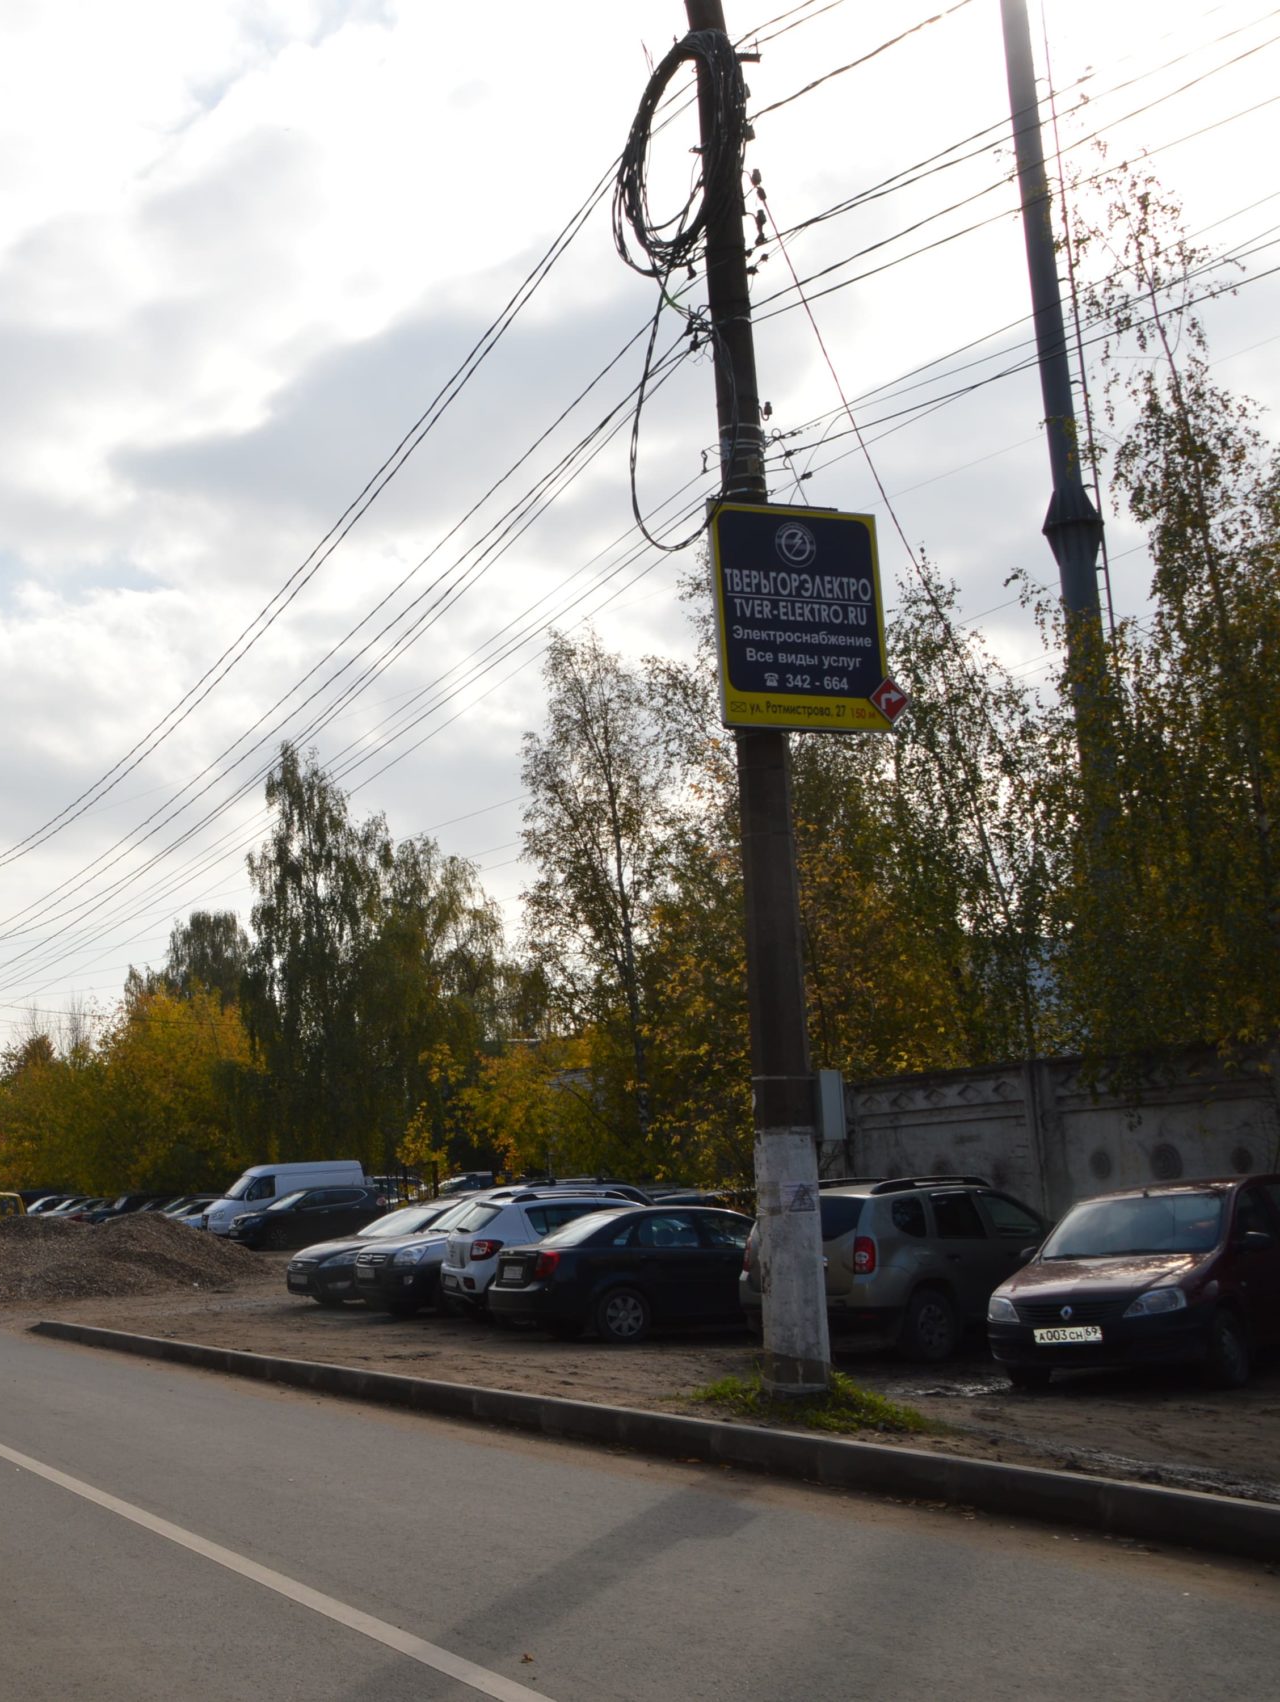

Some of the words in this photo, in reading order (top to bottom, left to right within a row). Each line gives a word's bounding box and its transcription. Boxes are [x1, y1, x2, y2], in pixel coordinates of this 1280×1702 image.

[724, 568, 871, 601] ТВЕРЬГОРЭЛЕКТРО
[734, 599, 867, 626] TVER-ELEKTRO.RU
[732, 626, 872, 648] Электроснабжение
[746, 648, 774, 663] Все
[778, 652, 819, 666] виды
[822, 655, 863, 670] услуг
[785, 674, 811, 689] 342
[823, 676, 849, 691] 664
